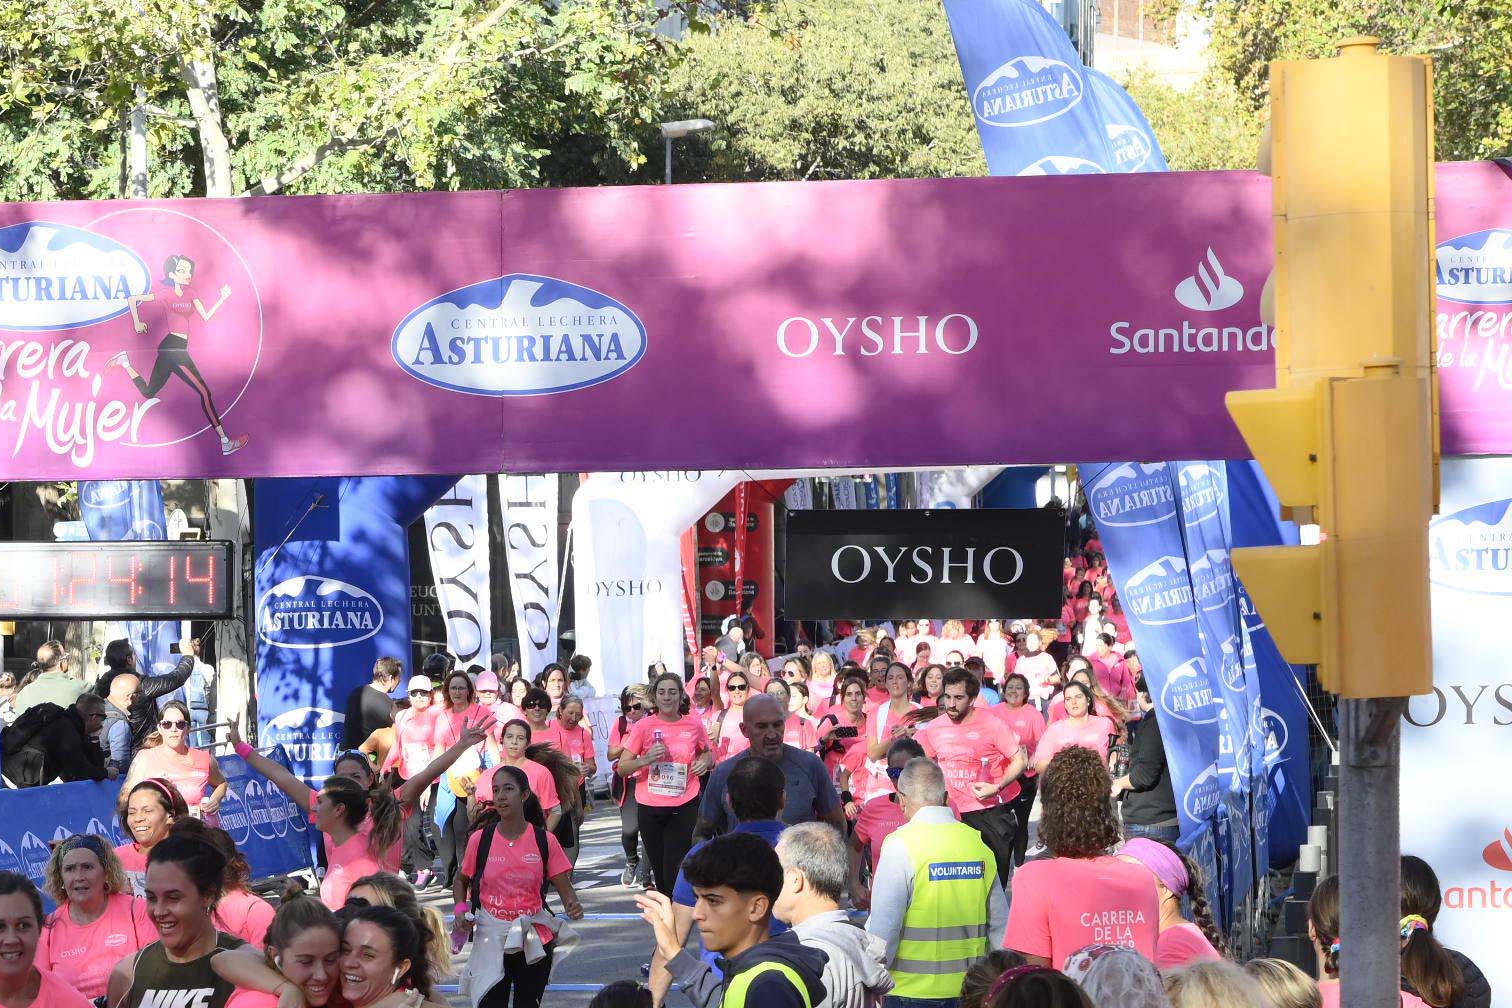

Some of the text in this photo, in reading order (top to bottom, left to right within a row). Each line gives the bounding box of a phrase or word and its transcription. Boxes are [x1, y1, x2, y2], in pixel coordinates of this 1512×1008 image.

[451, 315, 618, 329] CENTRAL LECHERA
[776, 313, 979, 358] OYSHO
[412, 322, 627, 365] ASTURIANA
[1109, 320, 1276, 355] Santand
[11, 373, 161, 468] Mujer
[831, 545, 1024, 585] OYSHO
[262, 604, 374, 633] ASTURIANA
[274, 599, 369, 610] CENTRAL LECHERA
[930, 866, 982, 877] VOLUNTARIS
[1080, 909, 1146, 928] CARRERA
[1094, 926, 1133, 941] DE LA
